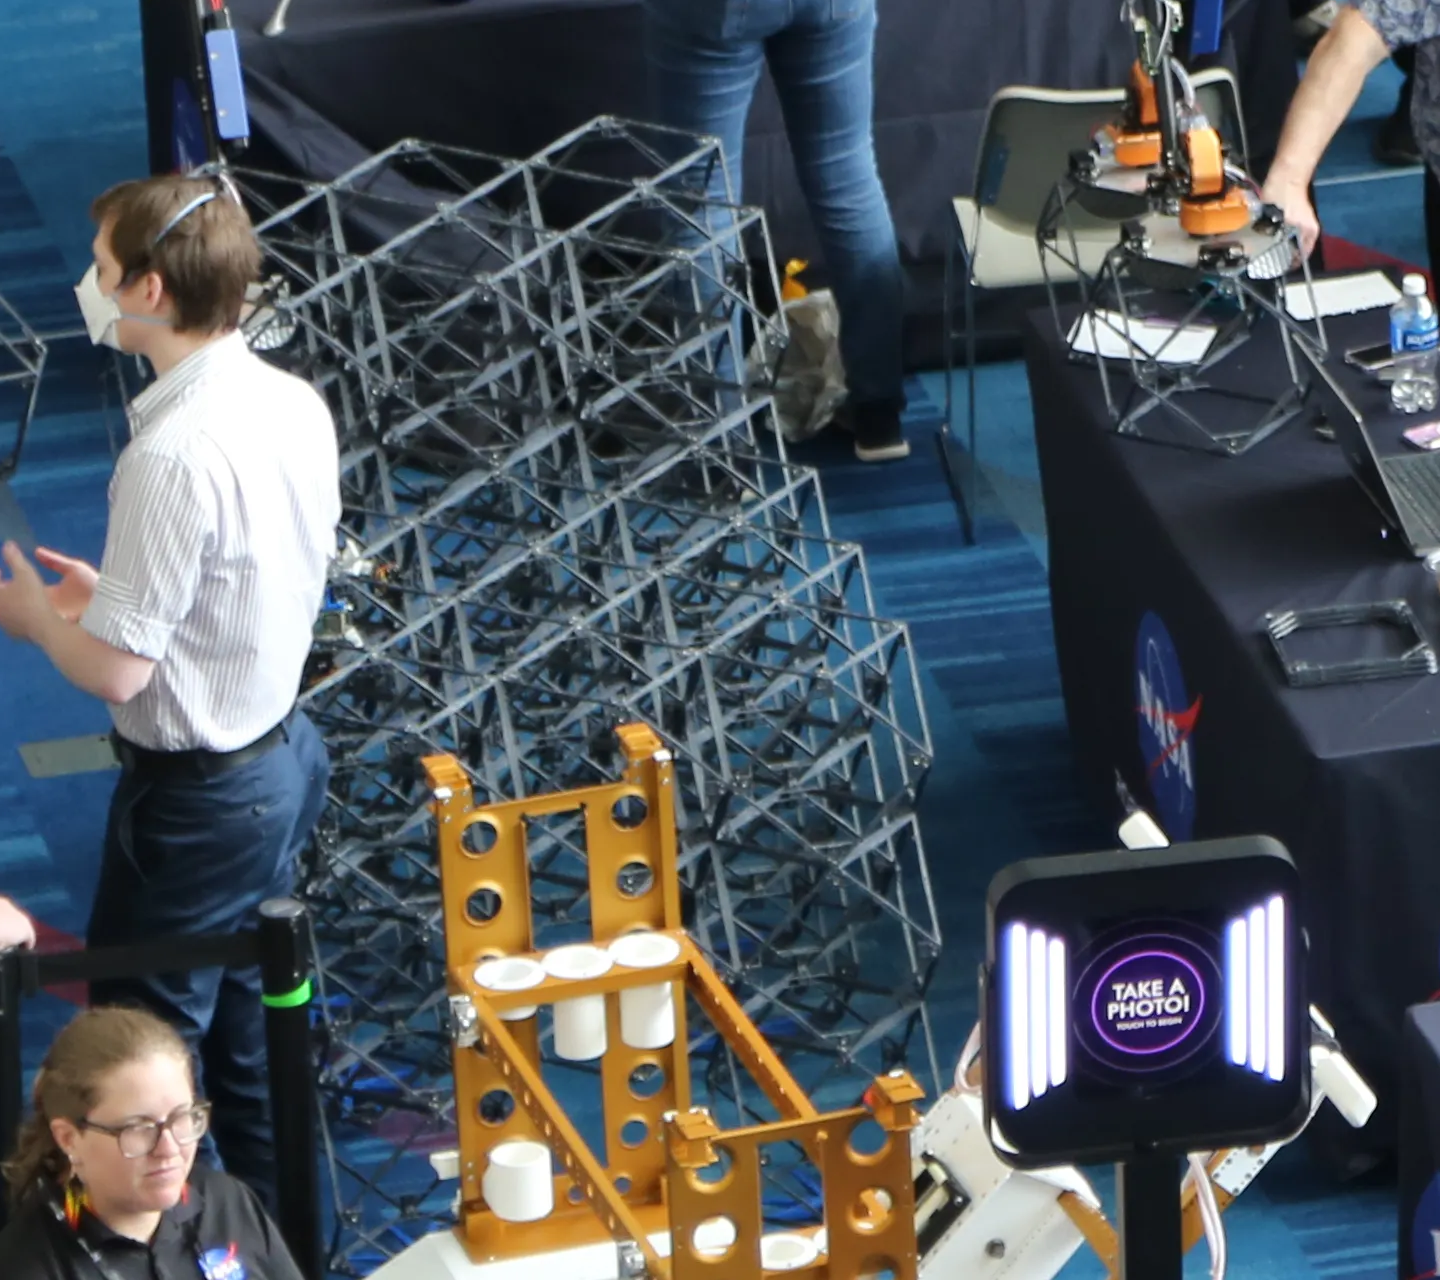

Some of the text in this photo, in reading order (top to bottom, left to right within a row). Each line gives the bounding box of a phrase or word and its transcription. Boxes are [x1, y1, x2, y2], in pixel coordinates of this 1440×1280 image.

[1138, 670, 1194, 792] NASA
[1111, 976, 1186, 1001] TAKE A
[1116, 1016, 1183, 1032] TOUCH TO BEGIN
